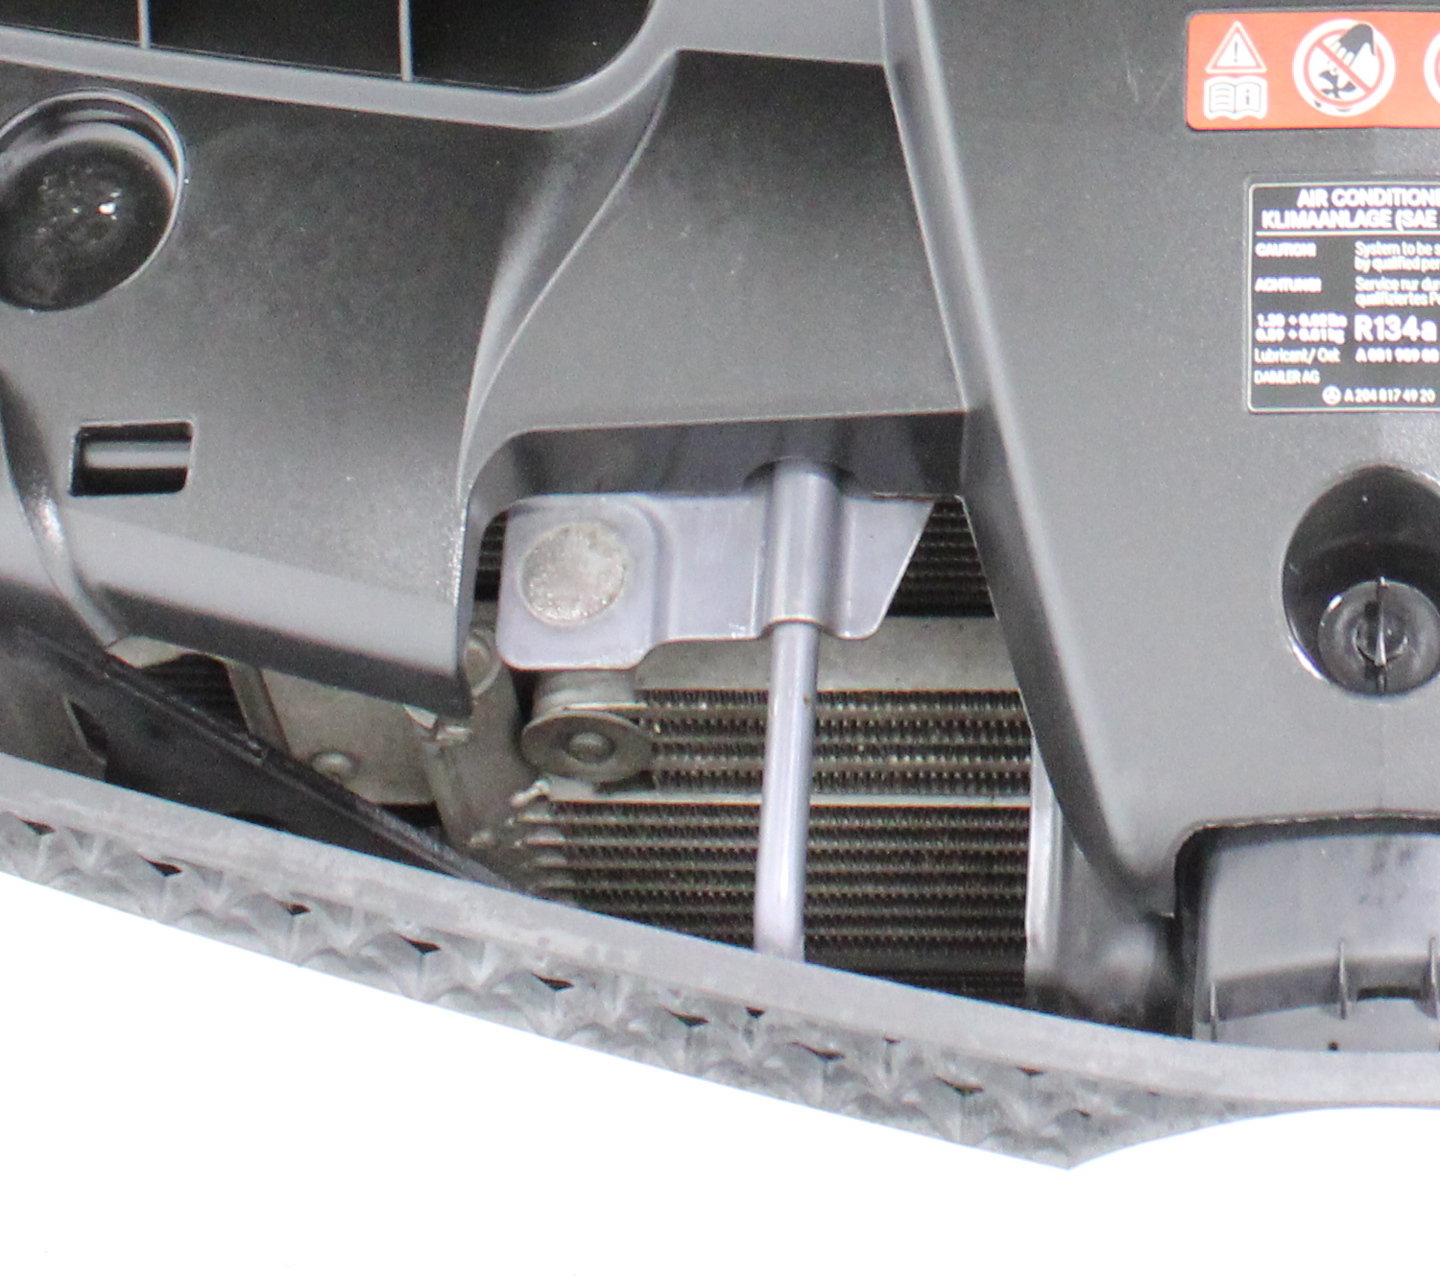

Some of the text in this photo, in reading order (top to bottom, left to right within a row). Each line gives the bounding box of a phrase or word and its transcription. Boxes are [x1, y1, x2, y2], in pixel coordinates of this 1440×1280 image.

[1297, 189, 1329, 207] AIR
[1261, 209, 1393, 229] KLIMAANLAGE
[1395, 209, 1438, 232] (SAE
[1355, 241, 1401, 258] System
[1402, 242, 1416, 256] to
[1417, 242, 1432, 256] be
[1354, 256, 1371, 273] by
[1355, 276, 1399, 292] Service
[1400, 279, 1419, 292] nur
[1354, 314, 1438, 342] R134a
[1355, 347, 1367, 363] A
[1254, 369, 1320, 385] DAIMLER AG
[1344, 389, 1354, 403] A
[1355, 389, 1379, 403] 204
[1419, 389, 1436, 403] 20
